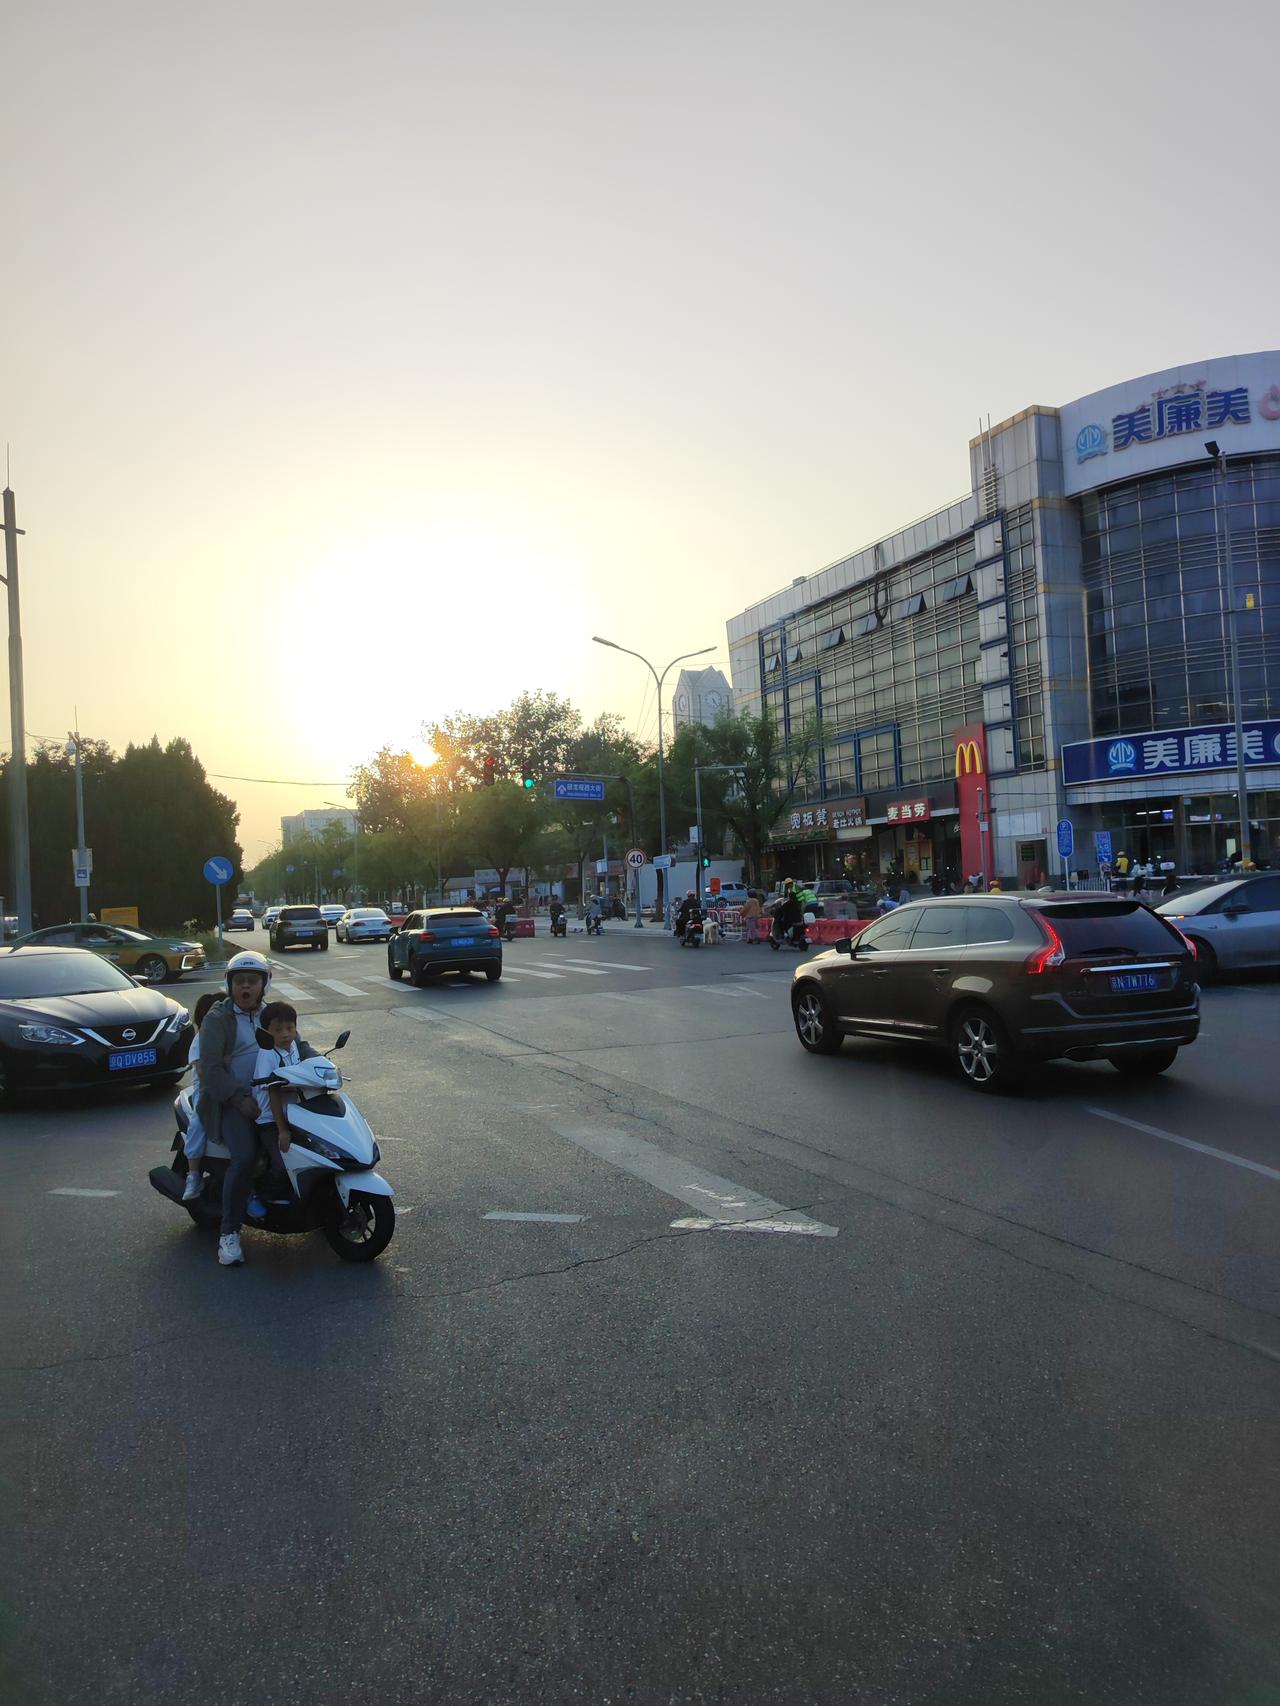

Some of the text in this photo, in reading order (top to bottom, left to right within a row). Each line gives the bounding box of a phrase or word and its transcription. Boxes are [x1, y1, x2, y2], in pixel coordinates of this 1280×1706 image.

[1112, 387, 1250, 451] 美廉美
[1143, 729, 1265, 770] 美廉美
[790, 808, 829, 830] 宽板凳
[887, 803, 926, 821] 麦当劳
[629, 854, 643, 864] 40
